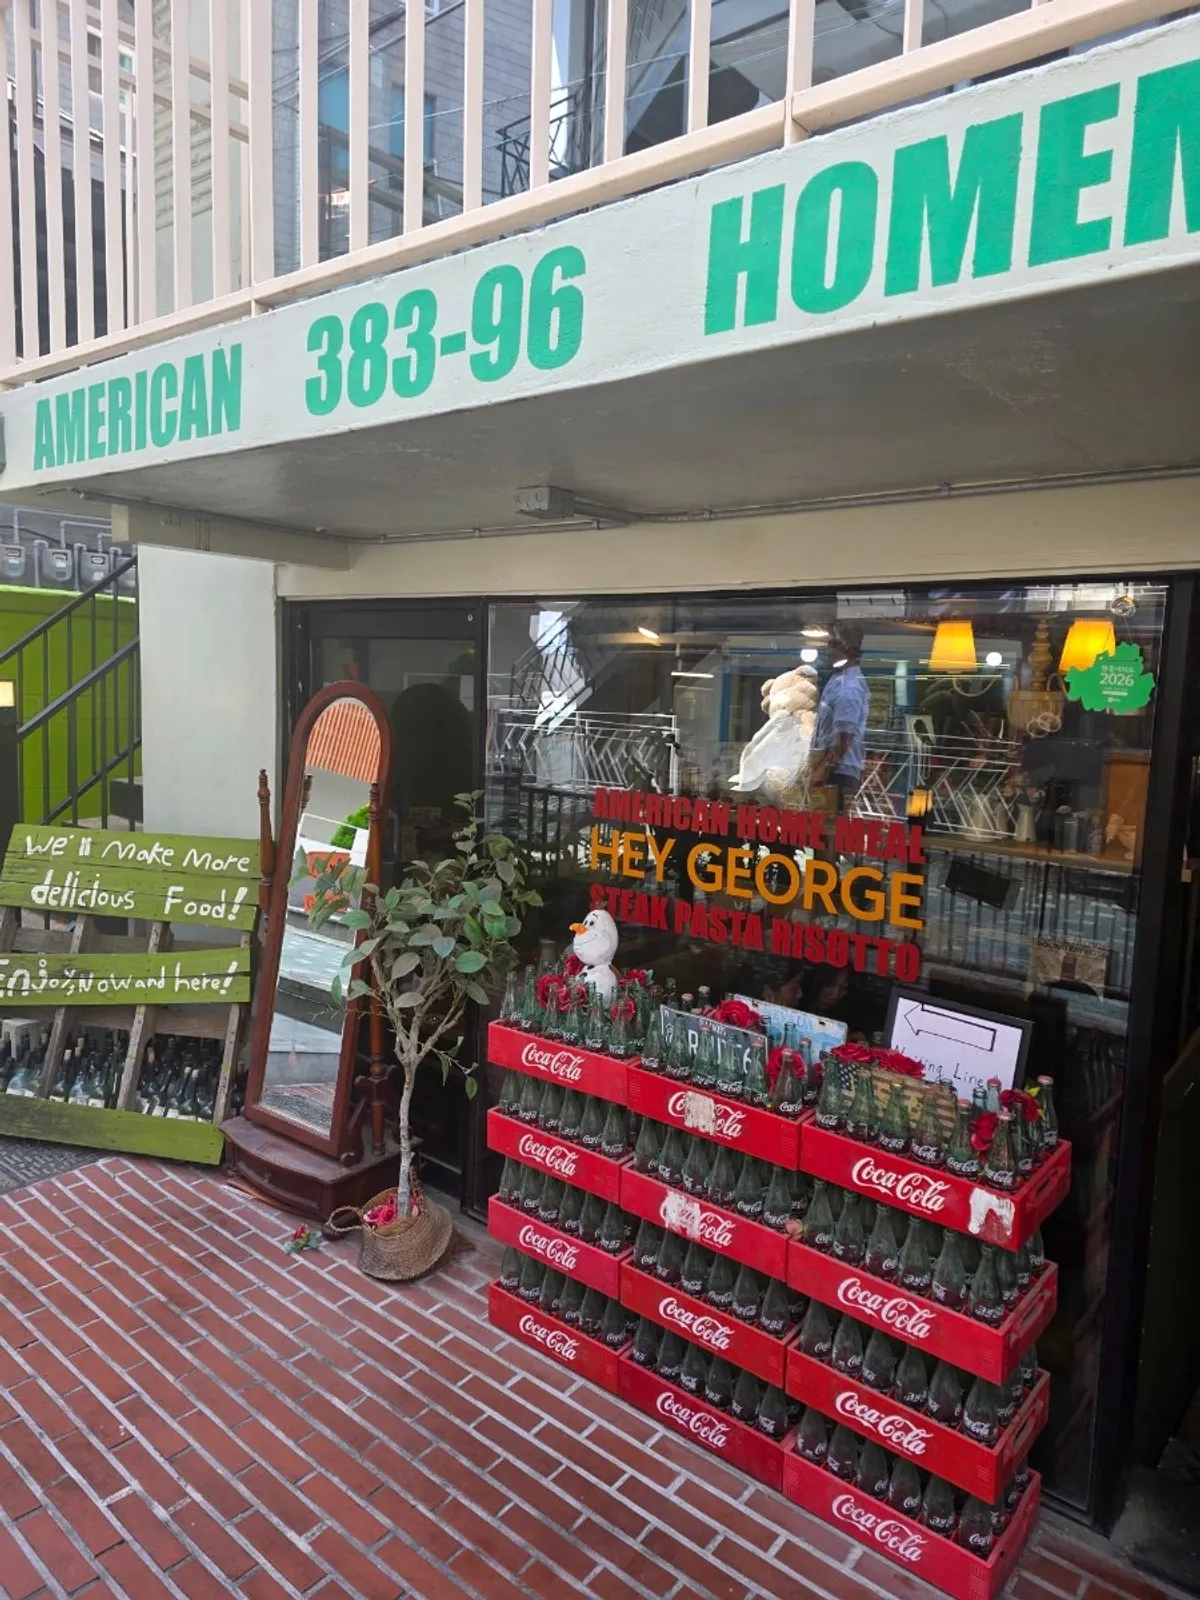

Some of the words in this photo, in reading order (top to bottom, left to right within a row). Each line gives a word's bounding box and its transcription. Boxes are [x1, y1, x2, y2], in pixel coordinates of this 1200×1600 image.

[33, 343, 243, 470] AMERICAN
[305, 245, 587, 416] 383-96
[1099, 673, 1135, 688] 2026
[592, 786, 730, 836] AMERICAN
[737, 804, 827, 849] HOME
[835, 815, 927, 865] MEAL
[30, 869, 135, 911] delicious
[164, 885, 248, 920] Food!
[589, 825, 676, 882] HEY
[686, 842, 925, 930] GEORGE
[589, 883, 668, 931] STEAK
[675, 900, 763, 950] PASTA
[771, 917, 923, 983] RISOTTO
[174, 960, 238, 995] here!
[953, 1062, 984, 1087] Line
